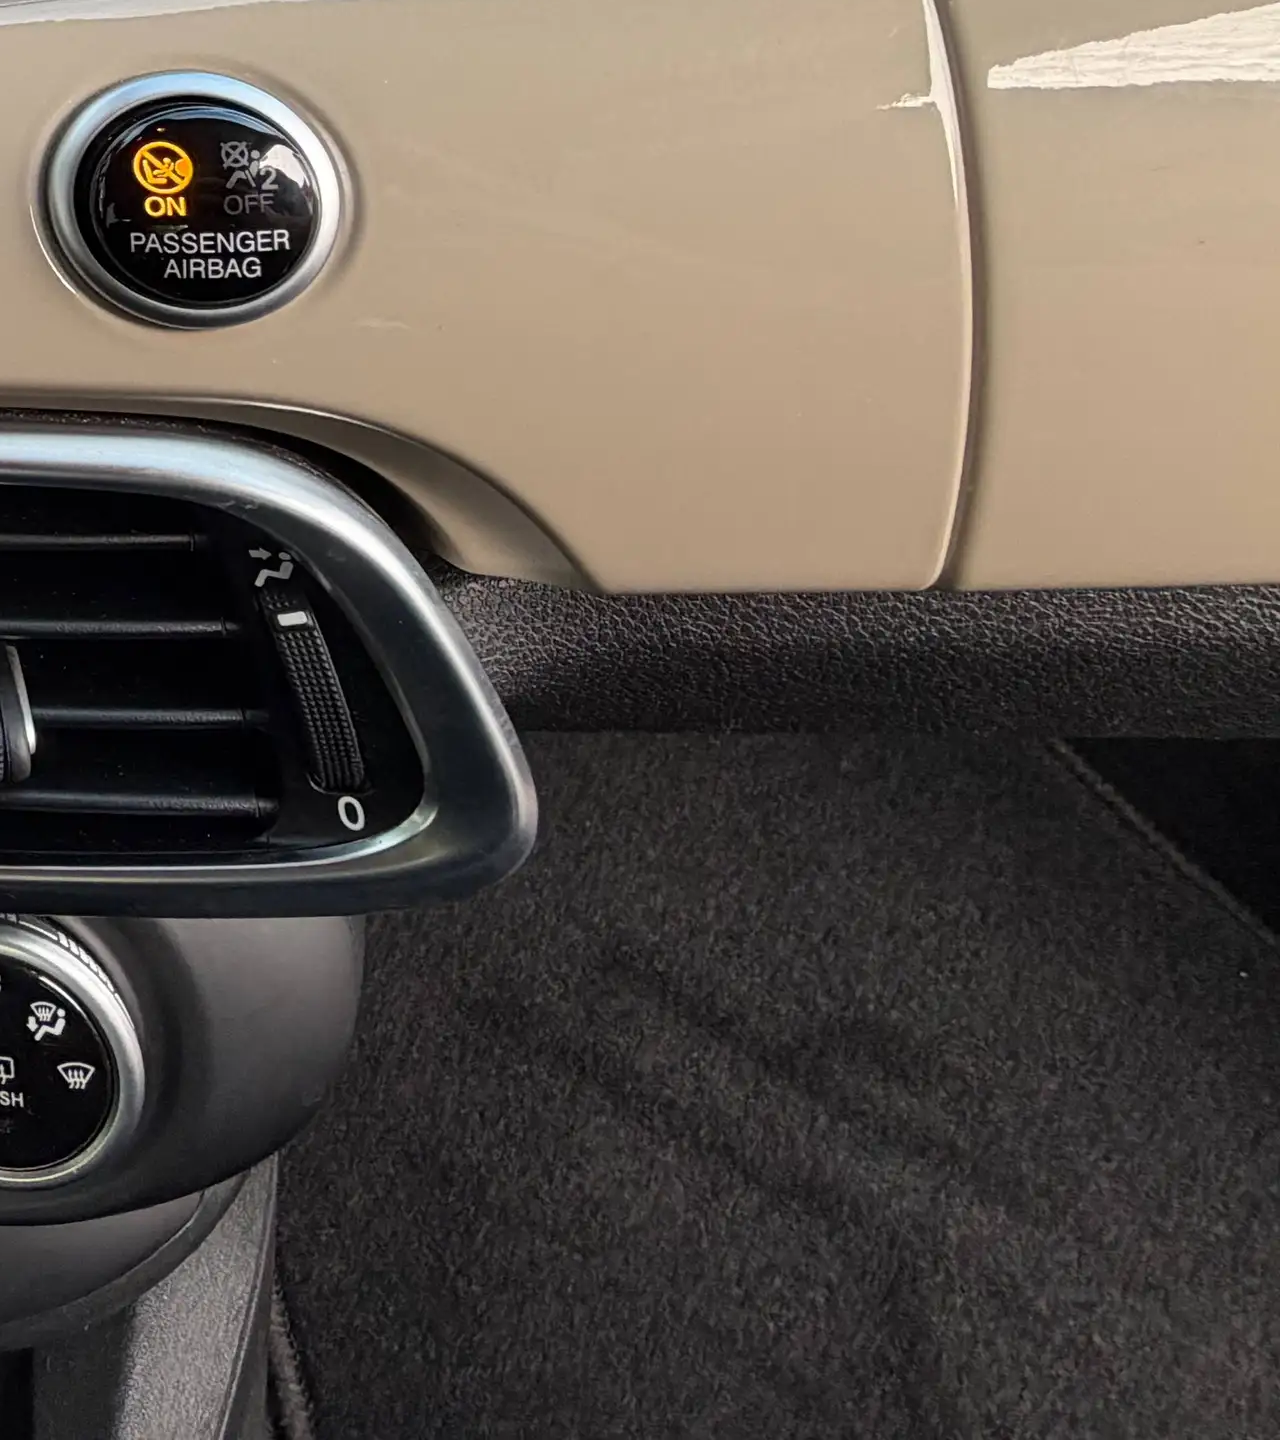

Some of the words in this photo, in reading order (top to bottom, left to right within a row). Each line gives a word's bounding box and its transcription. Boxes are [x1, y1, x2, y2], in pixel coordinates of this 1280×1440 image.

[144, 196, 186, 217] ON
[223, 193, 274, 215] OFF
[130, 230, 290, 253] PASSENGER
[164, 258, 262, 279] AIRBAG
